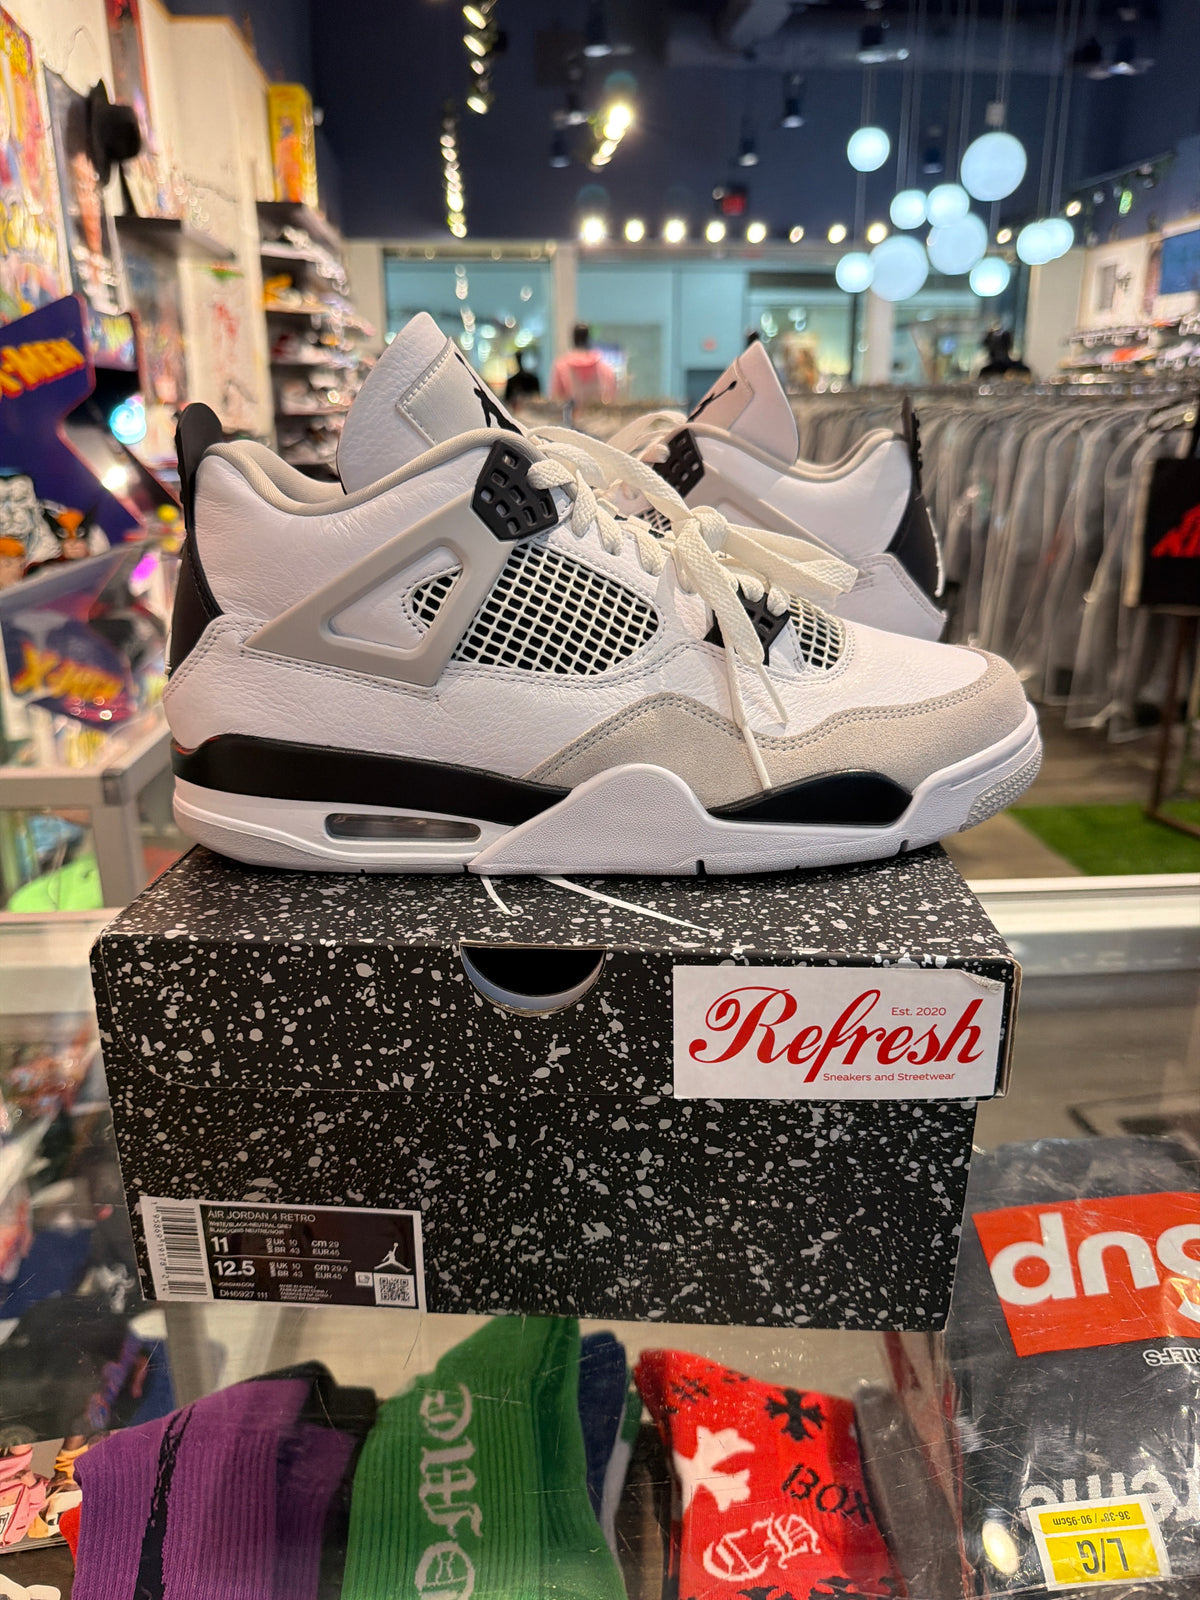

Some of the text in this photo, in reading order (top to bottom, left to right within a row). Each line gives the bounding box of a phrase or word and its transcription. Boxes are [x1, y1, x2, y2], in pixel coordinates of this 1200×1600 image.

[891, 1006, 947, 1017] Est. 2020
[688, 986, 984, 1083] Refresh
[823, 1072, 956, 1082] Sneakers and Streetwear
[207, 1210, 316, 1223] AIR JORDAN 4 RETRO
[210, 1236, 229, 1253] 11
[289, 1239, 298, 1247] 10
[311, 1240, 340, 1249] cm 29
[274, 1246, 301, 1255] BR 43
[213, 1260, 256, 1276] 12.5
[314, 1263, 330, 1271] cm
[292, 1270, 304, 1278] 43
[1052, 1515, 1093, 1527] 90-95cm
[1076, 1537, 1130, 1575] L/G
